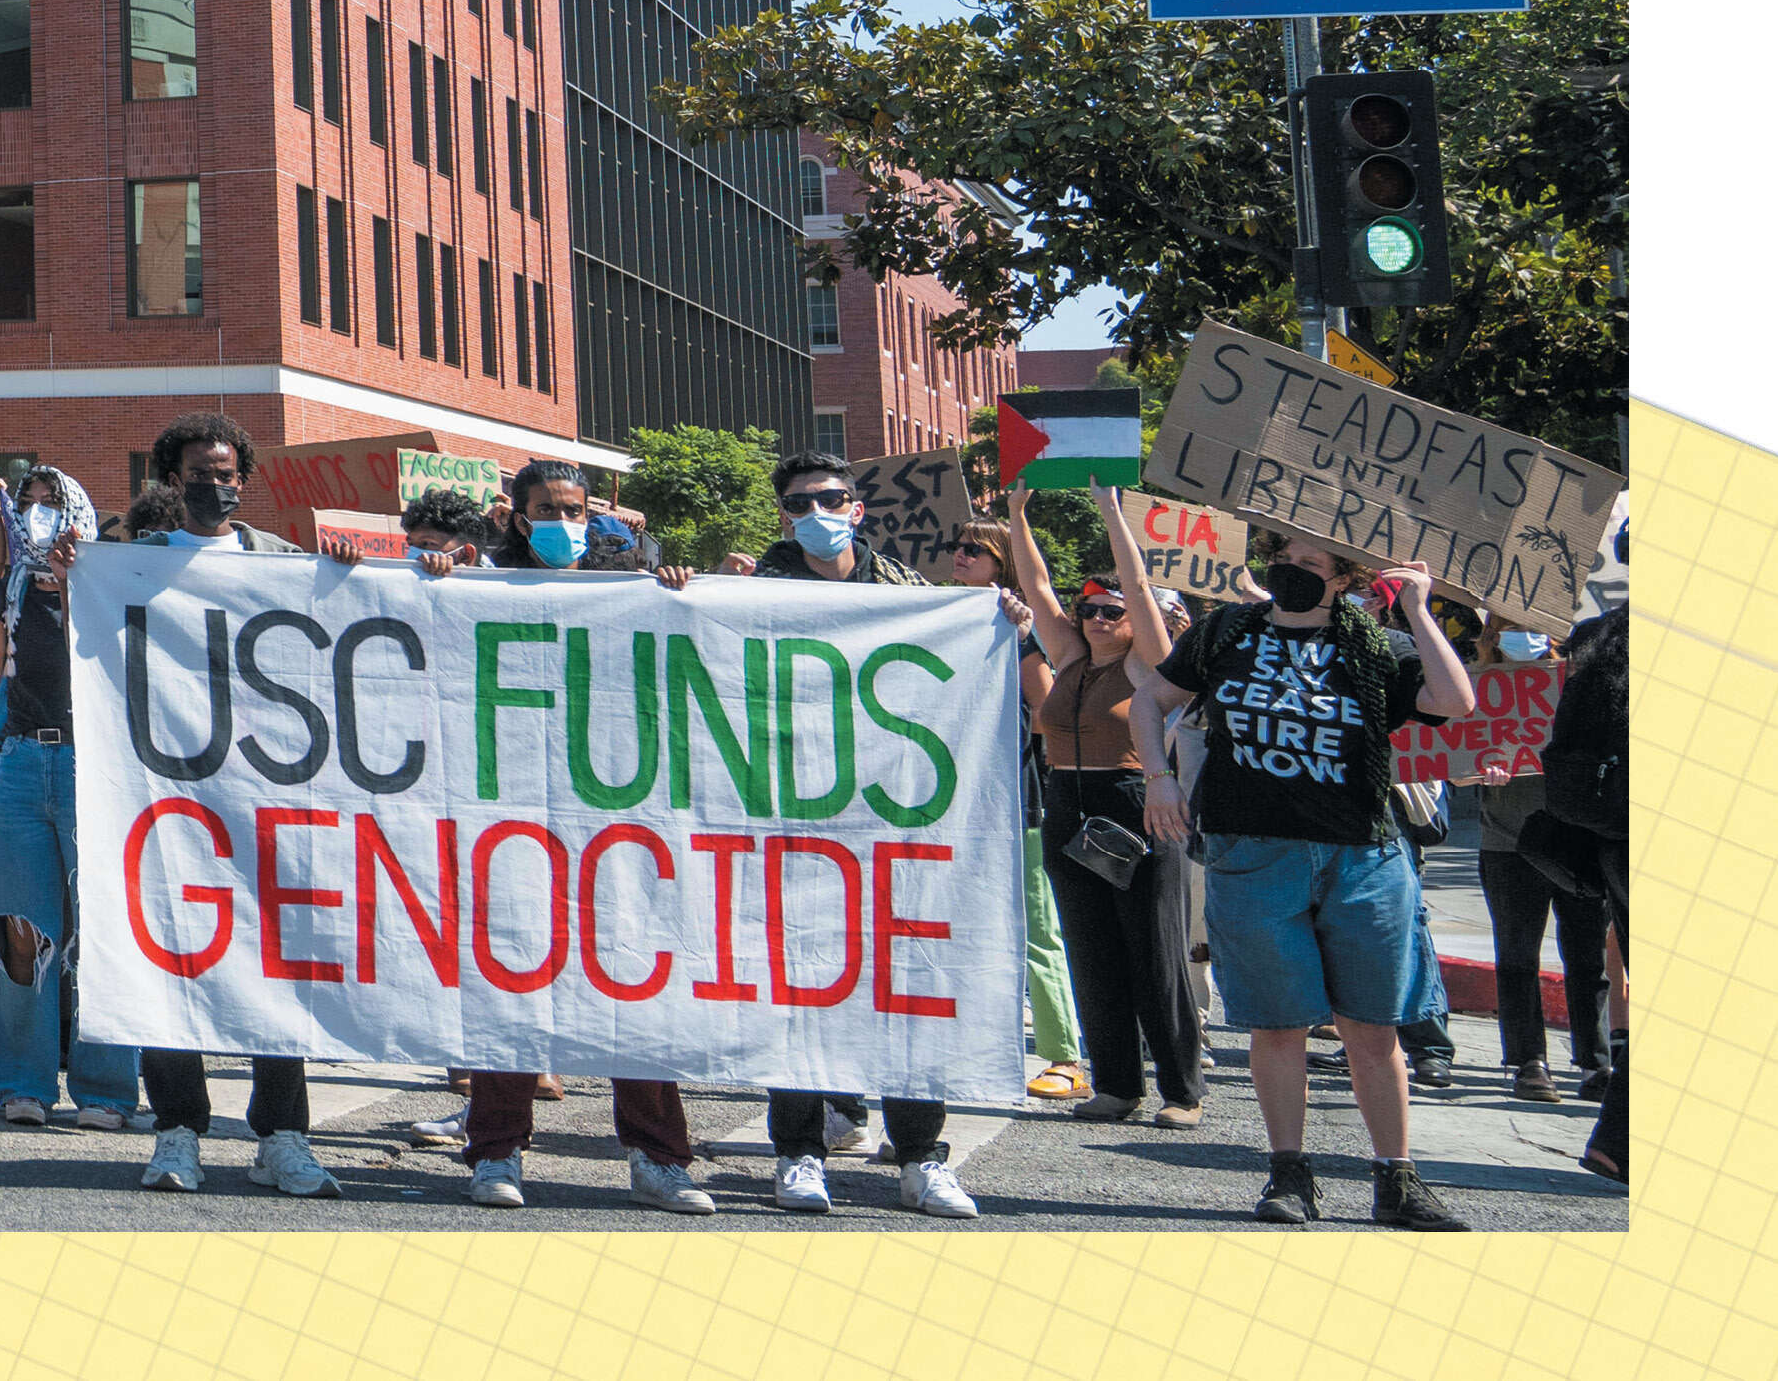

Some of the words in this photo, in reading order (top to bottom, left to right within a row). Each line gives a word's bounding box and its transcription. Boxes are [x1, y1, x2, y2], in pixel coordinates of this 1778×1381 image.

[1200, 343, 1587, 522] STEADFAST
[260, 453, 361, 511] HANDS
[399, 450, 499, 484] FAGGOTS
[855, 457, 958, 511] EST
[1312, 444, 1425, 505] UNTIL
[1144, 503, 1220, 554] CIA
[1175, 432, 1546, 612] LIBERATION
[1144, 548, 1183, 579] FF
[1189, 554, 1244, 596] USC
[1249, 655, 1332, 692] SAY
[124, 604, 427, 795] USC
[474, 621, 959, 829] FUNDS
[1215, 679, 1364, 727] CEASE
[1225, 709, 1345, 758] FIRE
[1232, 741, 1348, 785] NOW
[1397, 752, 1449, 784] IN
[1474, 746, 1545, 777] GA
[123, 796, 959, 1019] GENOCIDE
